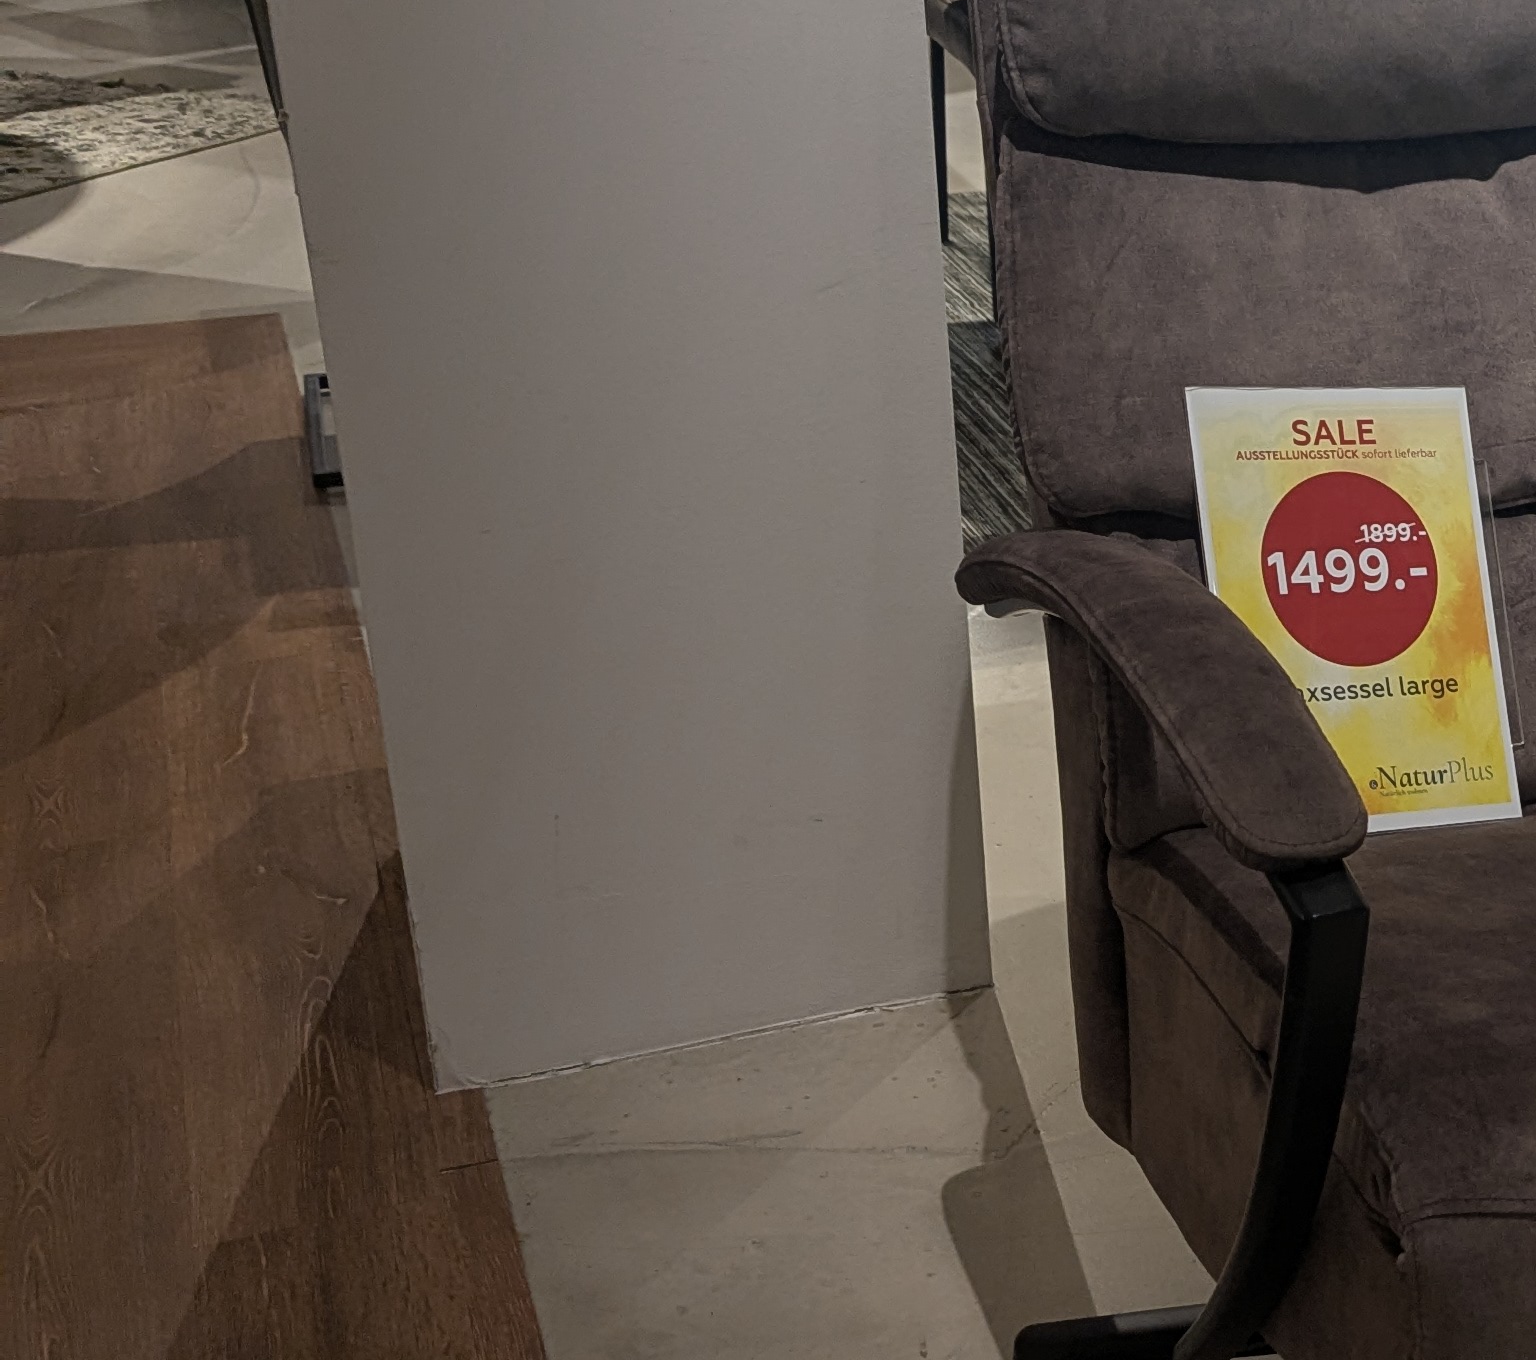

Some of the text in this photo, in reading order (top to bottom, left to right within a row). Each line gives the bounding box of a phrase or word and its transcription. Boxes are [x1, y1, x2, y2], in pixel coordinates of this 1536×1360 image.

[1291, 419, 1377, 446] SALE
[1236, 448, 1437, 461] AUSSTELLUNGSSTÜCK sofort lieferbar
[1357, 522, 1427, 543] 1899.-
[1267, 547, 1428, 595] 1499.-
[1399, 676, 1459, 699] large
